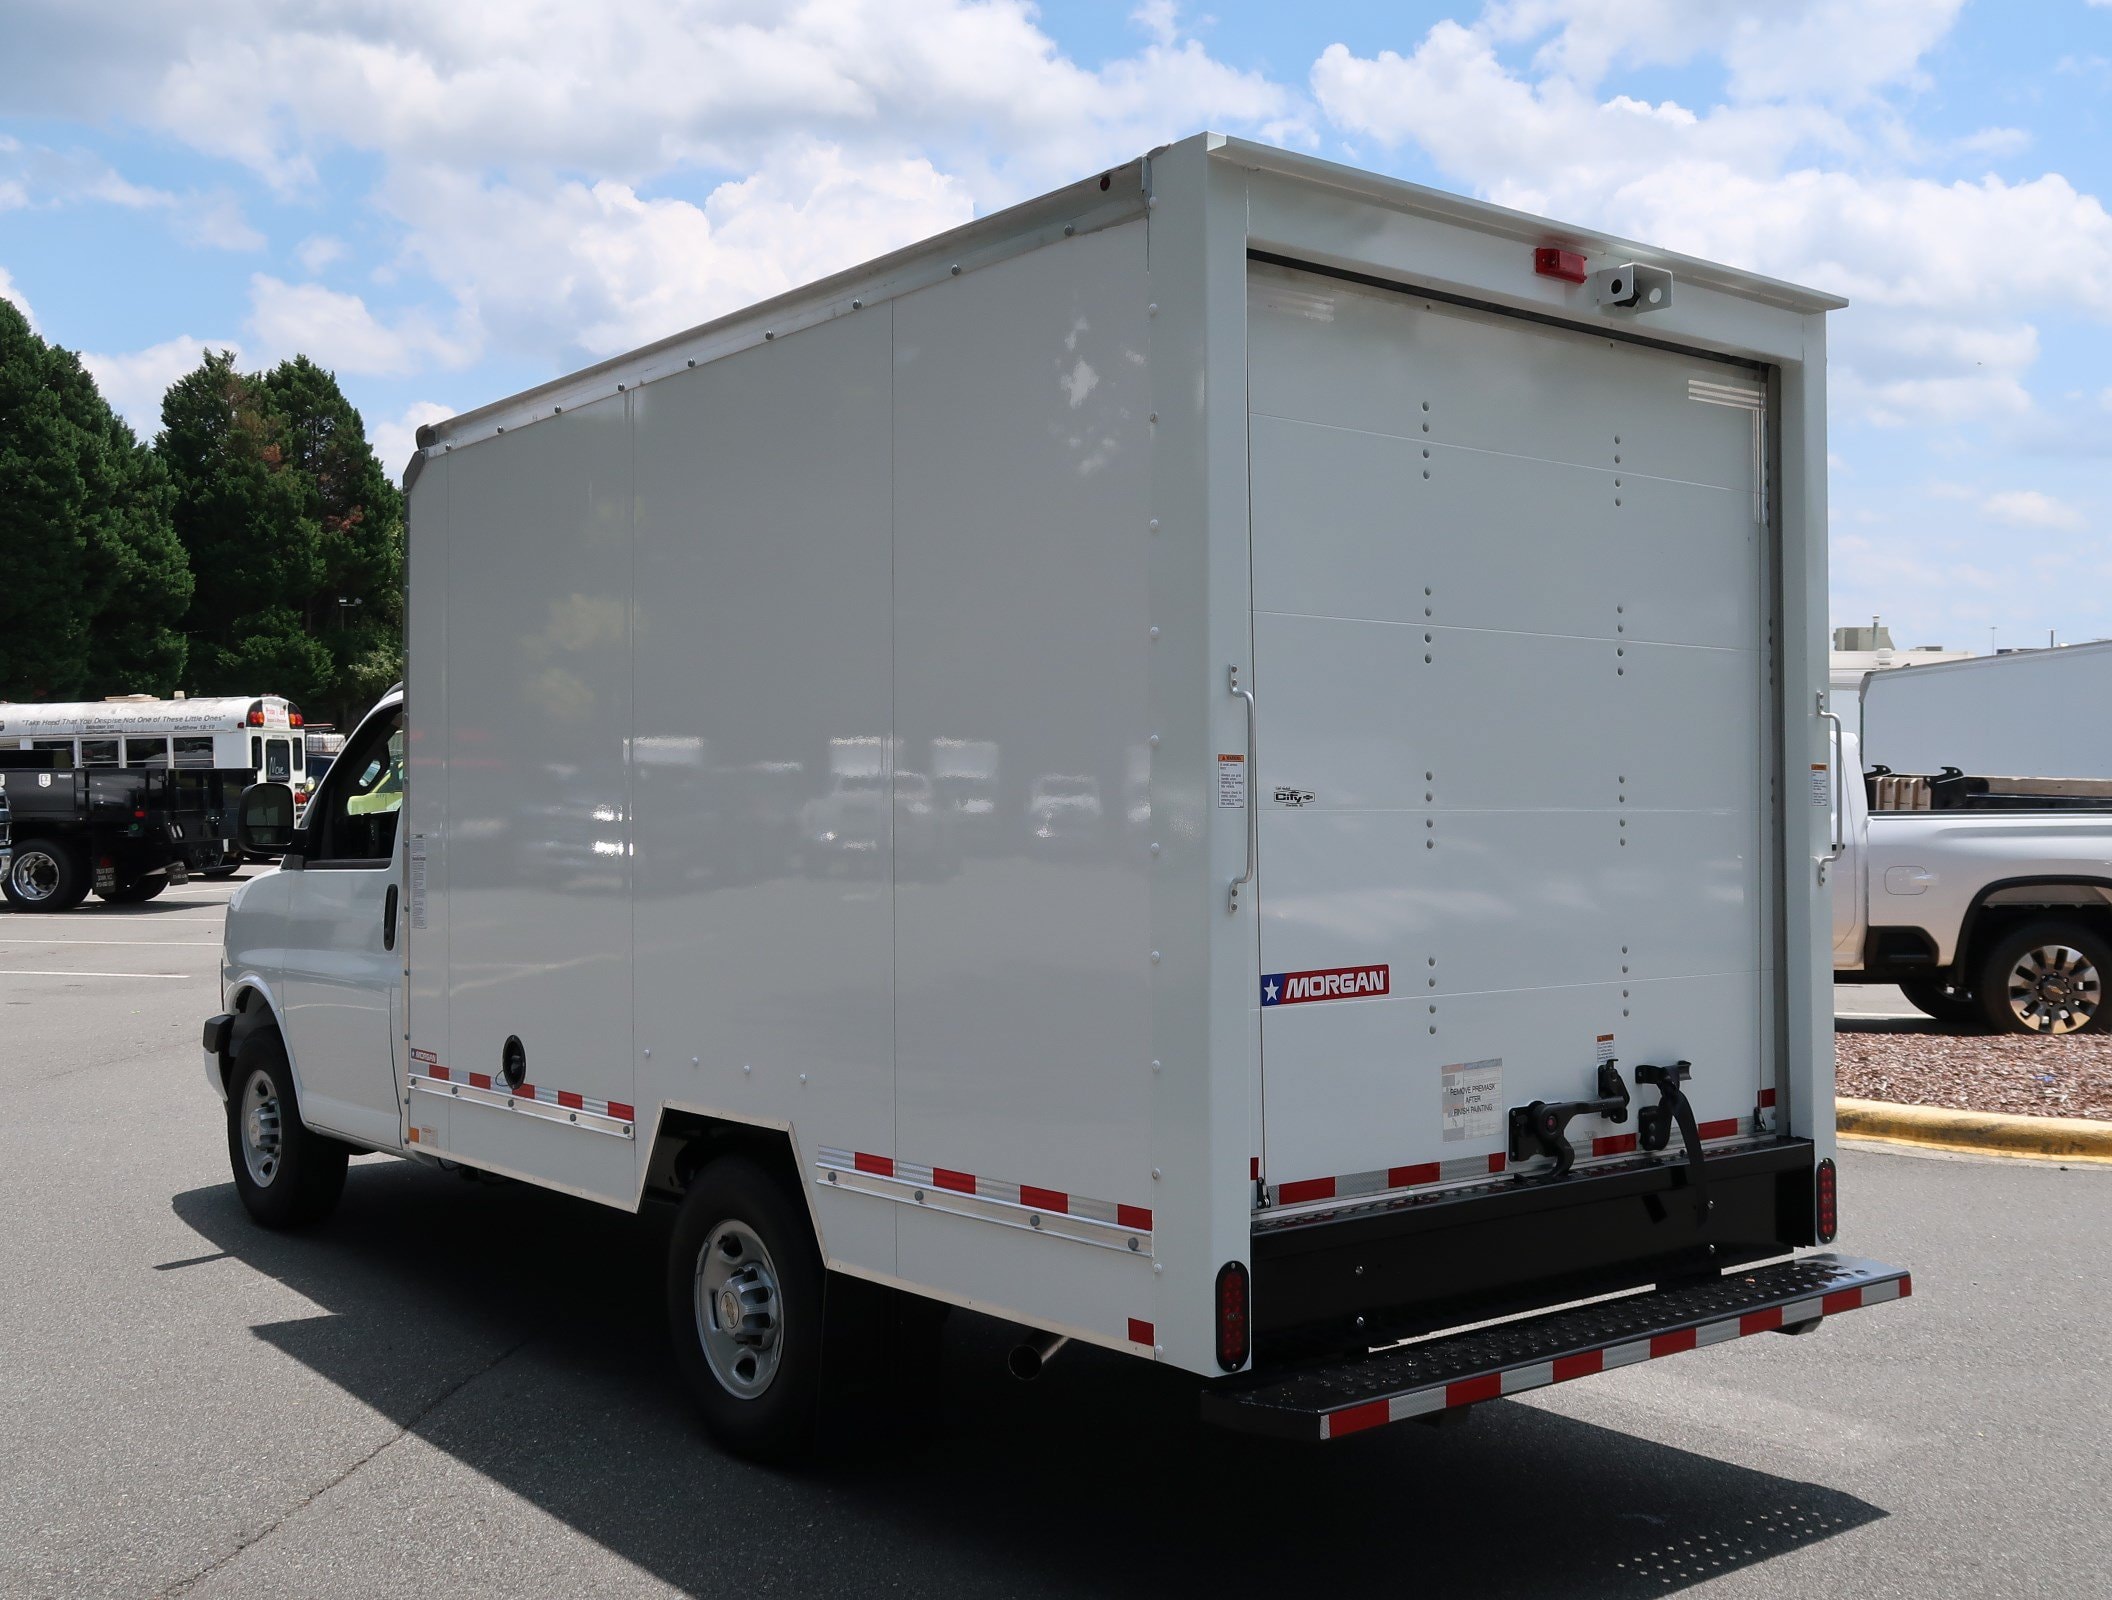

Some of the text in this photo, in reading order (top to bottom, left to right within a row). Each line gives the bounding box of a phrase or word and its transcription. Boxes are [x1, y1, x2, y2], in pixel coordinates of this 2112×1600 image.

[94, 717, 121, 725] Despise
[1275, 793, 1303, 803] City
[1285, 970, 1385, 1000] MORGAN
[1450, 1083, 1496, 1096] REMOVE PREMASK
[1466, 1095, 1481, 1104] AFTER
[1453, 1103, 1493, 1117] FINISH PAINTING
